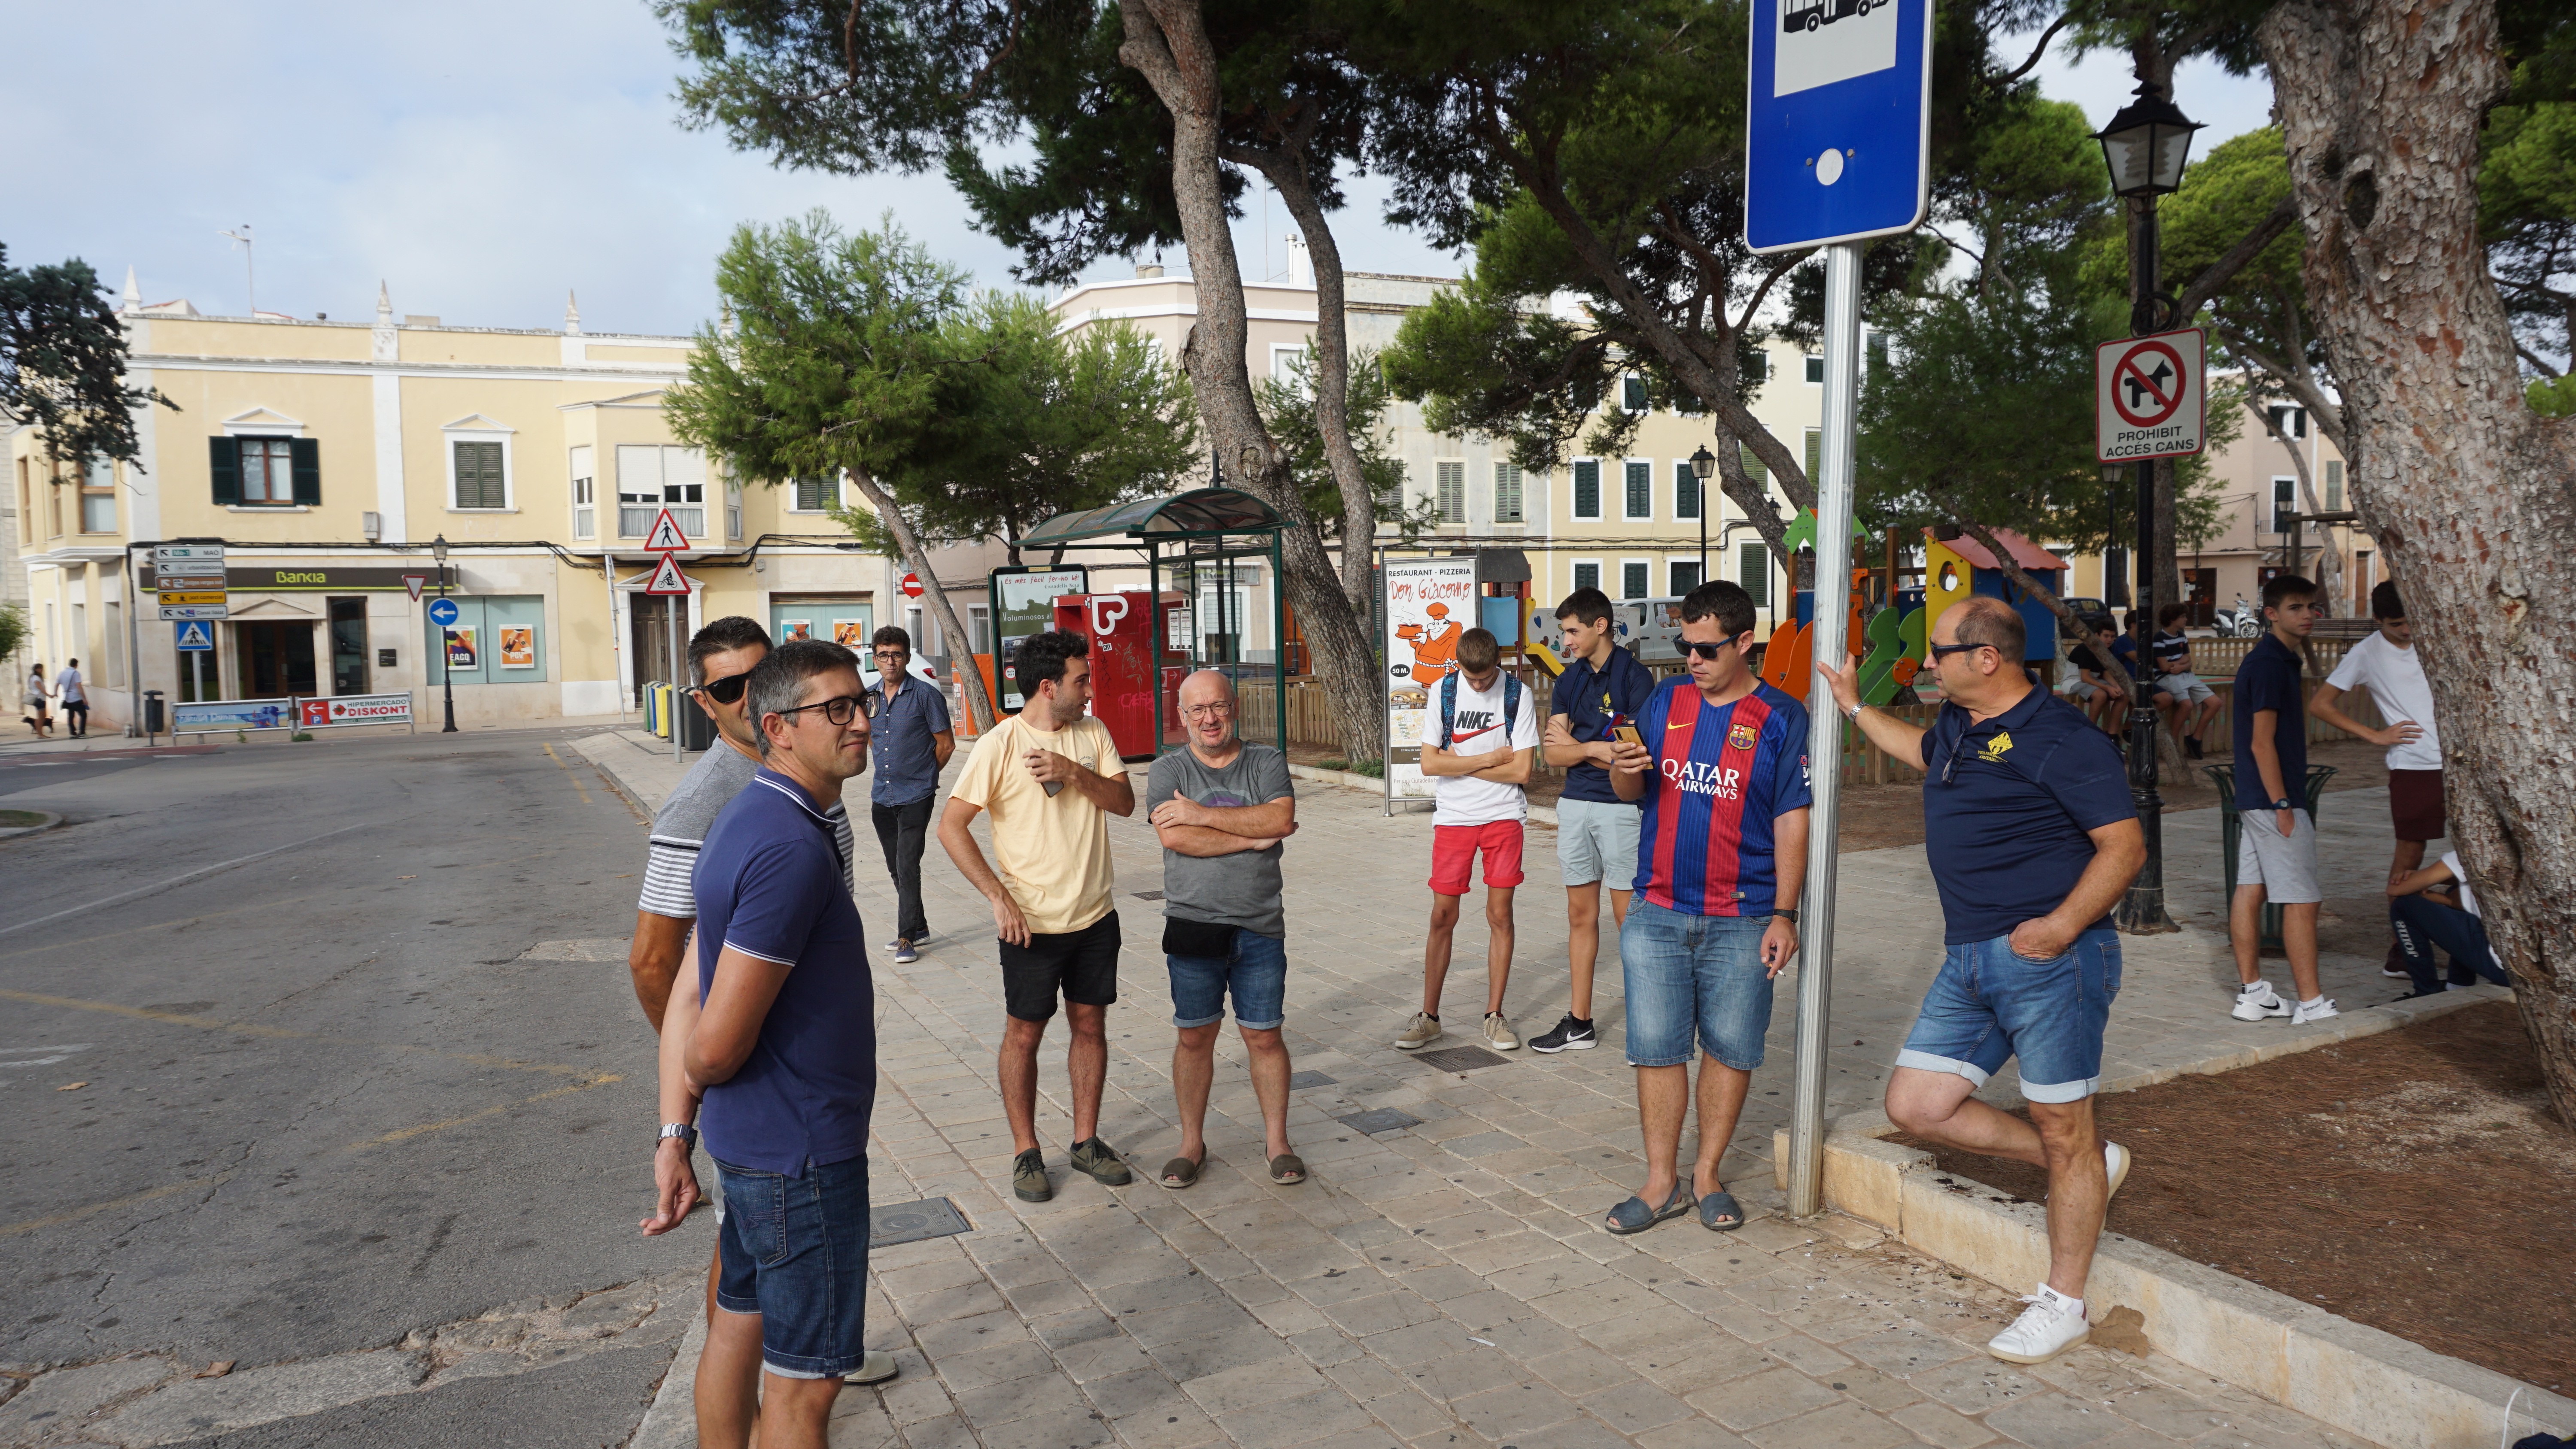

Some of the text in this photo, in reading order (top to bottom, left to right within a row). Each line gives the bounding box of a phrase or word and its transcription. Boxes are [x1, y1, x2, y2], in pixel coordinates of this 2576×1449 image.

[2118, 426, 2182, 442] PROHIBIT
[2105, 439, 2194, 457] ACCÉS CANS
[276, 571, 326, 583] Bankia
[1030, 576, 1045, 584] fàcil
[1389, 578, 1472, 603] Don Giacomo
[1002, 612, 1044, 622] Voluminosos
[347, 699, 406, 707] HIPERMERCADO
[348, 705, 407, 716] DISKONT
[1455, 711, 1494, 729] NIKE
[1662, 758, 1740, 788] QATAR
[1675, 779, 1738, 800] AIRWAYS
